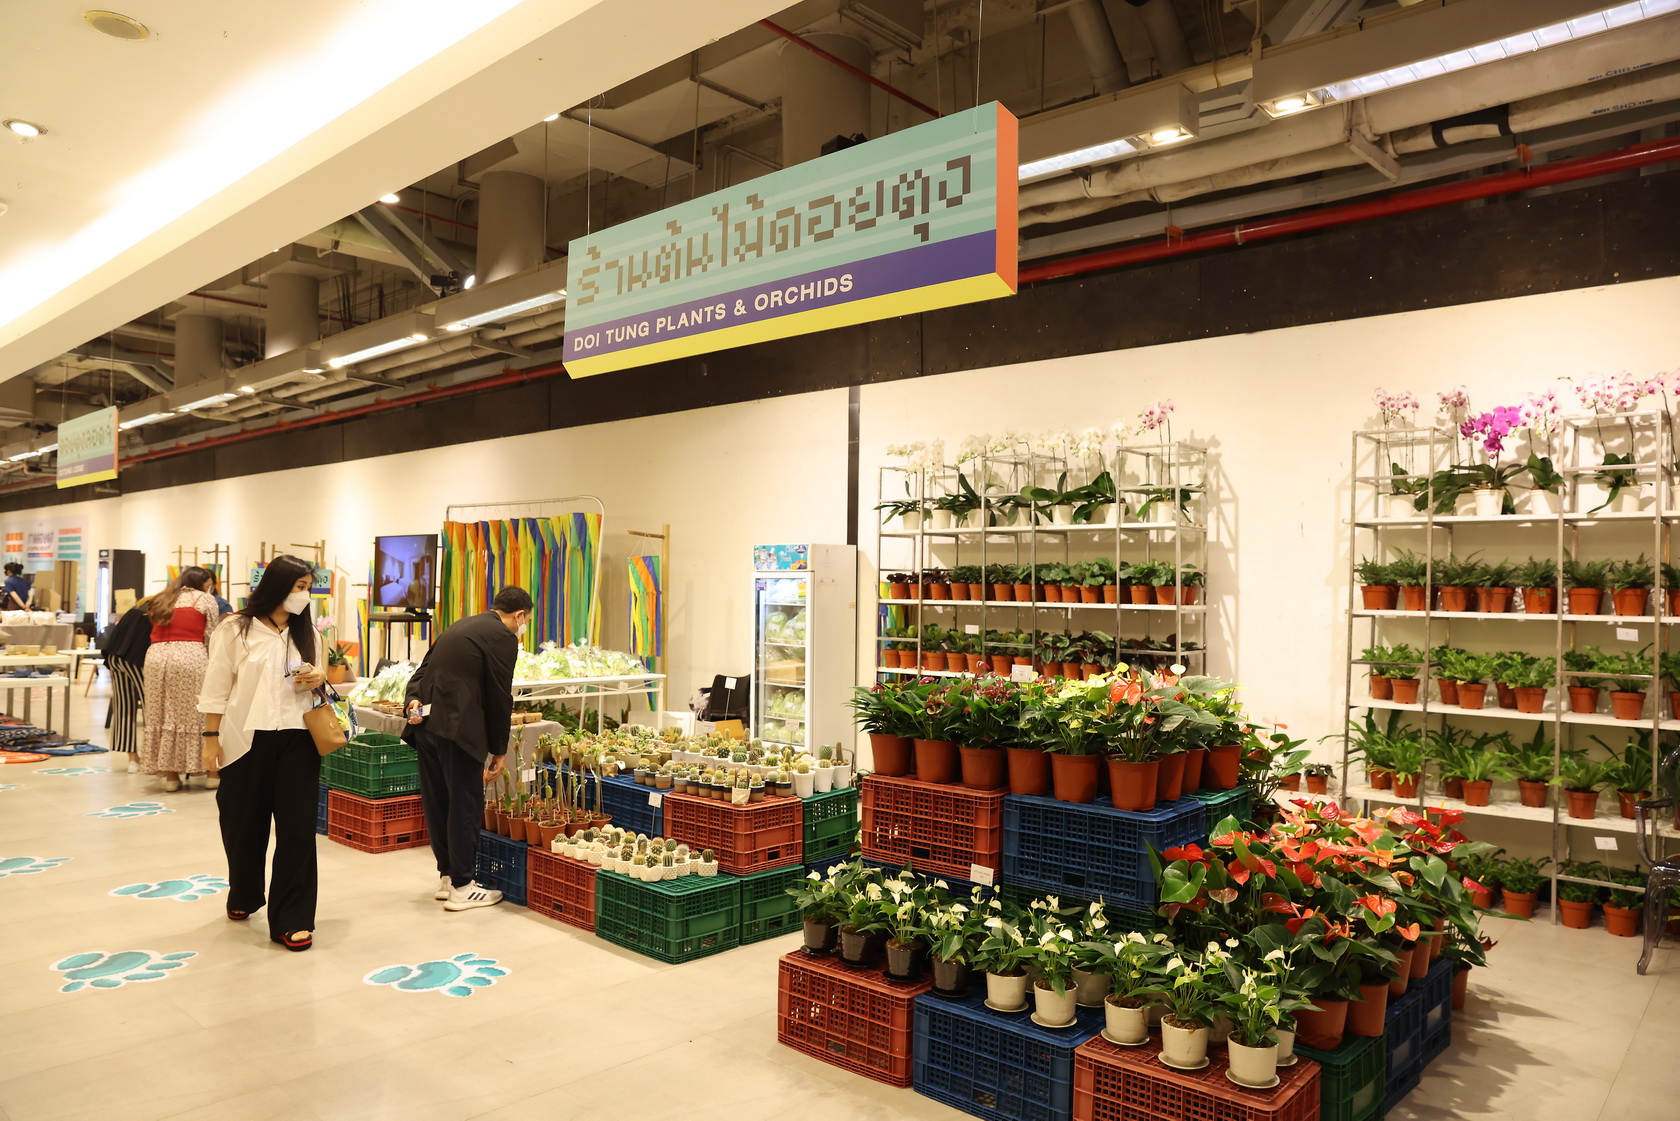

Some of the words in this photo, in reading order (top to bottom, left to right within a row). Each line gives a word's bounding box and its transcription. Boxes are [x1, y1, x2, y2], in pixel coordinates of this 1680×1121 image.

[576, 155, 972, 306] ร้านต้นไม้ดอยตุง
[573, 332, 600, 352] DOI
[605, 321, 650, 345] TUNG
[656, 303, 726, 334] PLANTS
[733, 298, 747, 317] &
[754, 273, 853, 312] ORCHIDS
